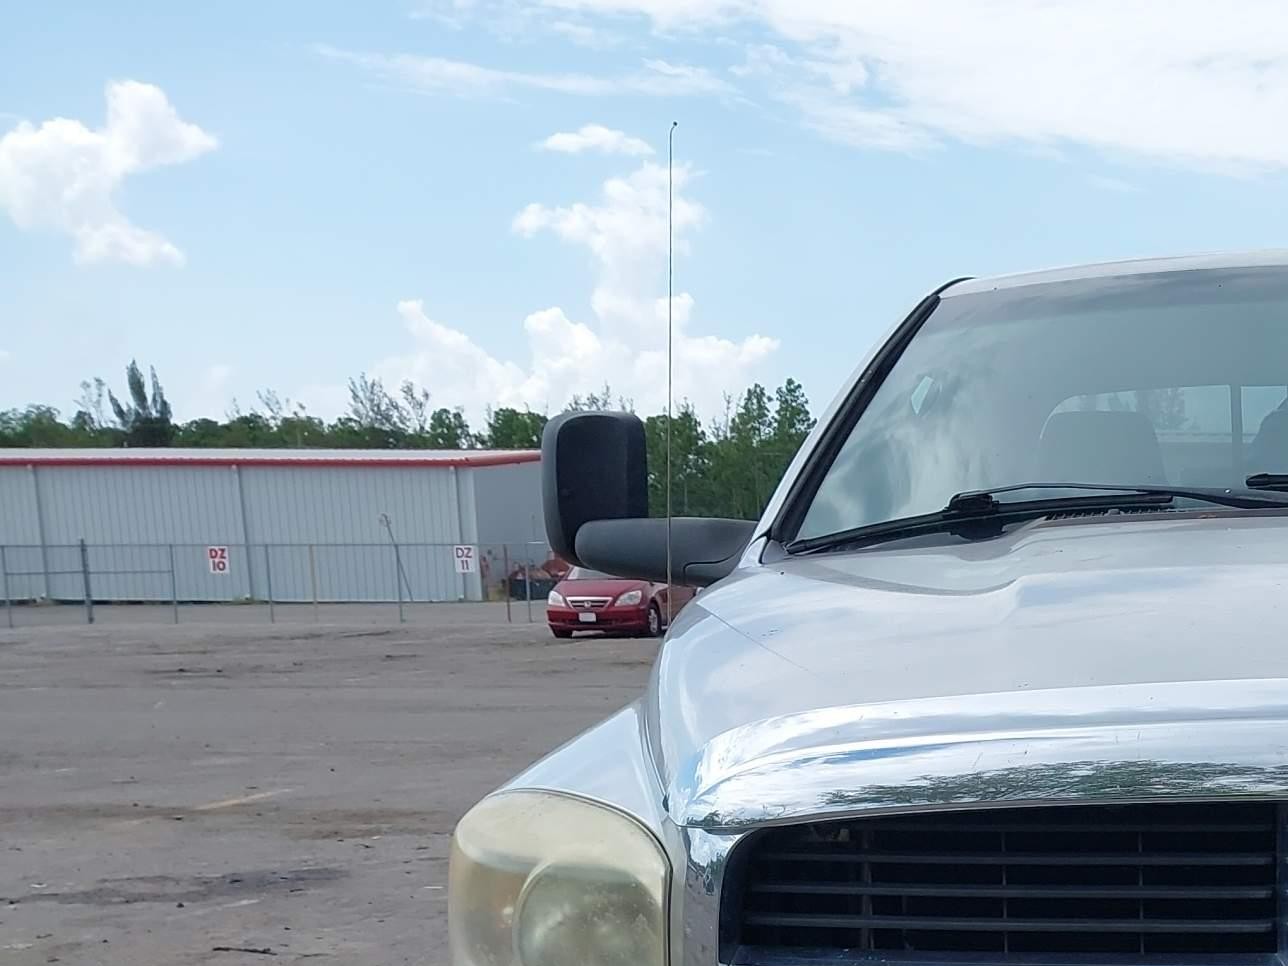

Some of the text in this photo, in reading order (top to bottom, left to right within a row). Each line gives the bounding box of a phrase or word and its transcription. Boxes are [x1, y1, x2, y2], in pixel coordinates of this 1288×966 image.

[209, 548, 226, 560] DZ
[456, 547, 473, 559] DZ
[212, 560, 226, 571] 10
[460, 560, 470, 571] 11
